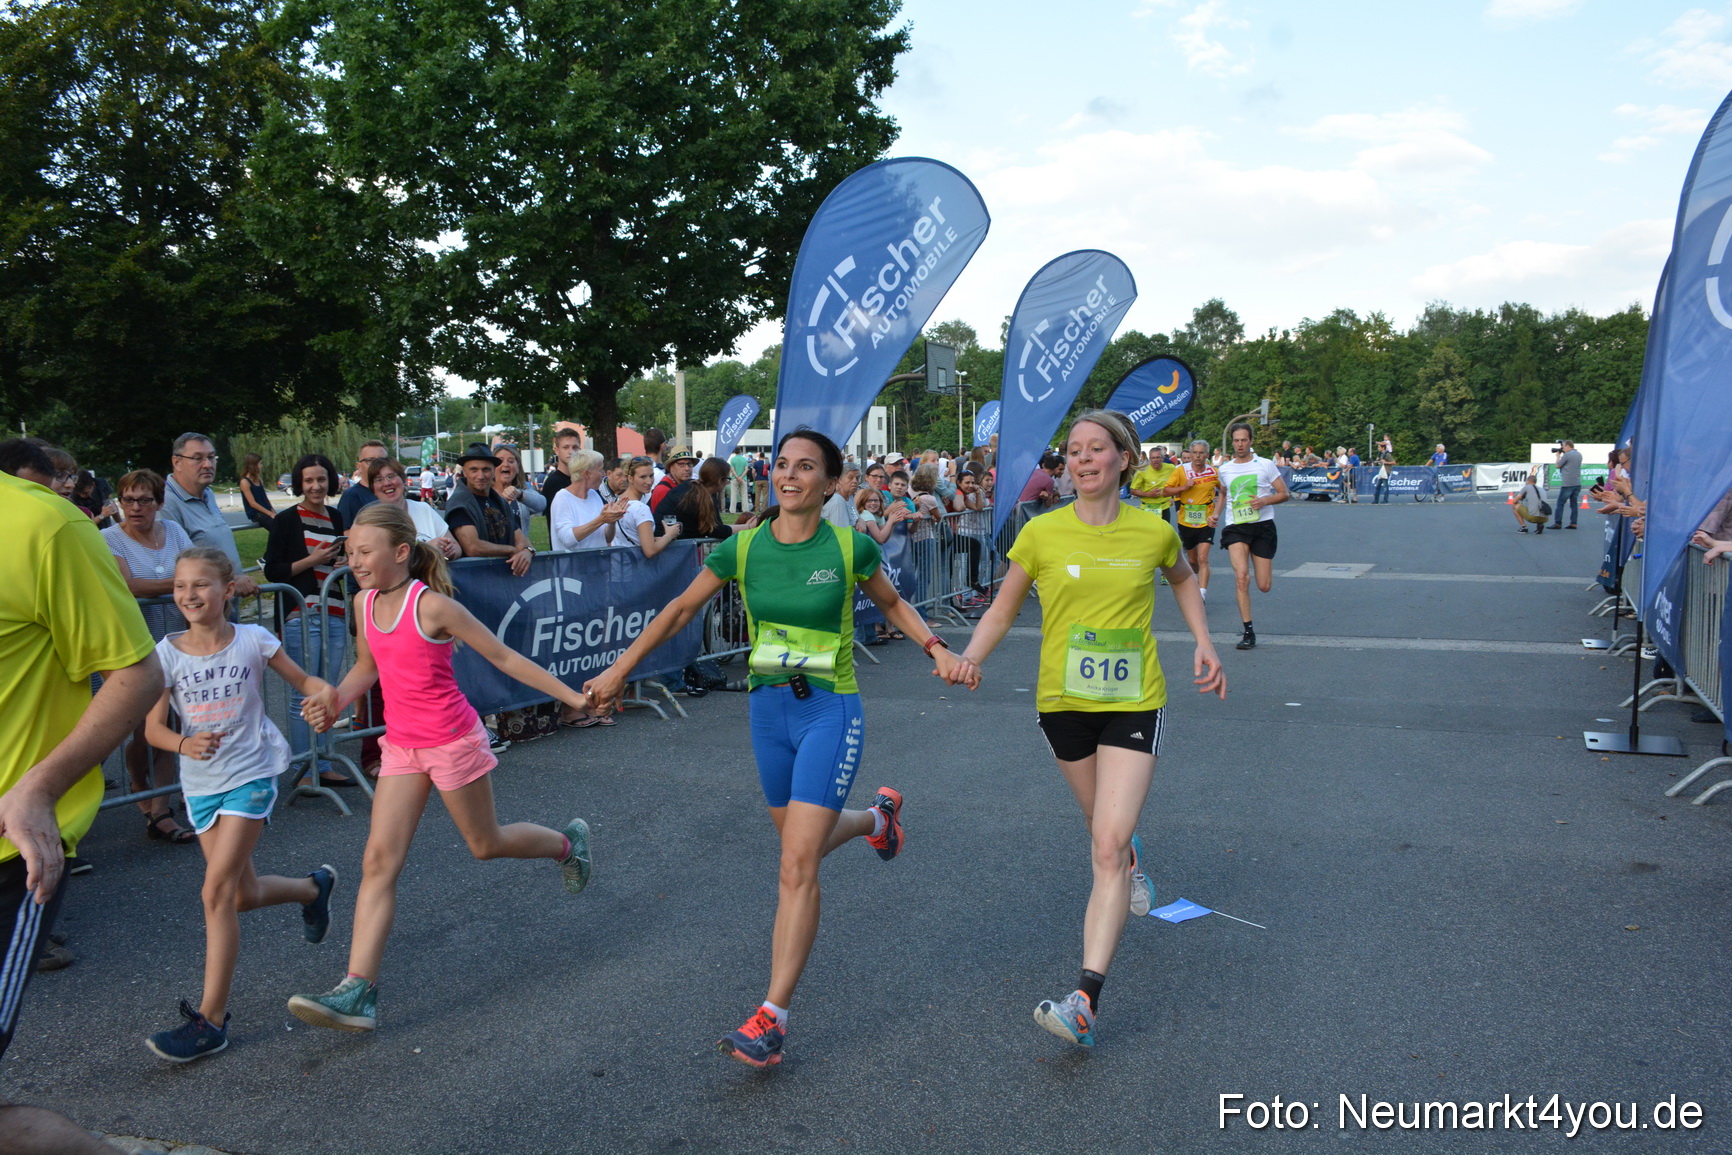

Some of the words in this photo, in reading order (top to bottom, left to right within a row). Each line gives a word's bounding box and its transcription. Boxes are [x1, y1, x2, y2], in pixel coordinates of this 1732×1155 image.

[833, 196, 946, 350] Fischer
[870, 226, 958, 349] AUTOMOBILE
[1036, 274, 1108, 384] Fischer
[1061, 294, 1117, 382] AUTOMOBILE
[725, 402, 752, 438] Fischer
[981, 406, 1001, 436] Fischer
[1128, 395, 1165, 423] mann
[1140, 411, 1157, 427] Druck
[1156, 405, 1169, 415] und
[1168, 389, 1190, 408] Medien
[1292, 474, 1328, 483] Frischmann
[1388, 477, 1423, 486] ischer
[1237, 507, 1254, 517] 113
[806, 568, 839, 584] AOK
[531, 606, 656, 657] Fischer
[177, 665, 251, 691] STENTON
[1079, 656, 1129, 681] 616
[183, 681, 243, 703] STREET
[835, 717, 862, 798] skinfit
